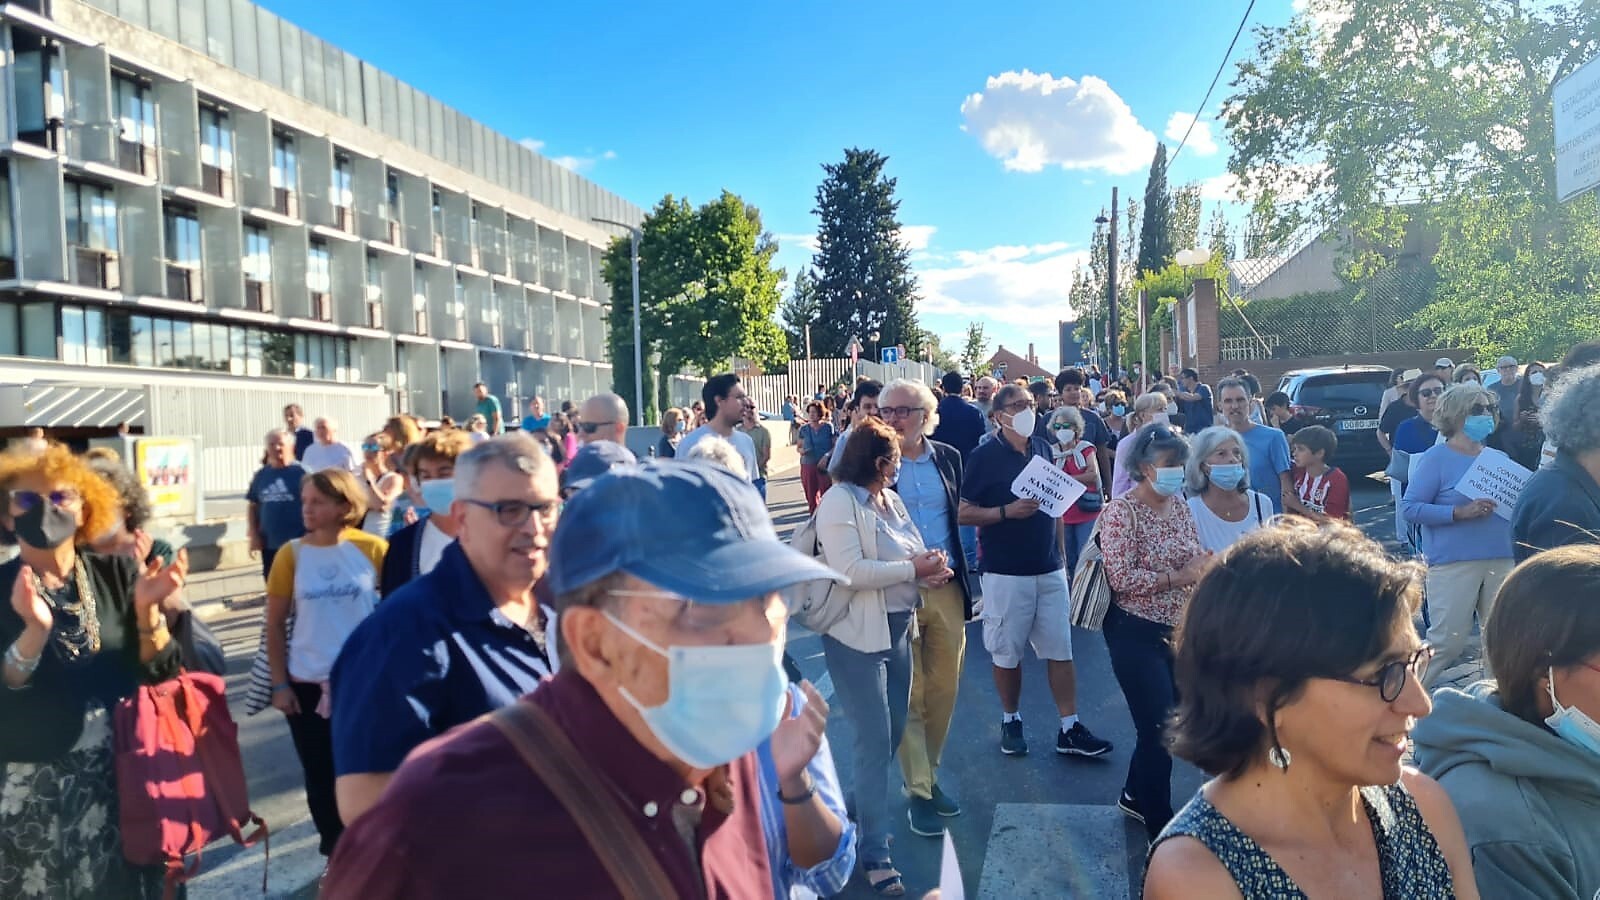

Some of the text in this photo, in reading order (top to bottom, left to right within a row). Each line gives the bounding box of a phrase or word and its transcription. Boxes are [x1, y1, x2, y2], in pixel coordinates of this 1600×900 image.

[1477, 465, 1521, 492] DESMANTELAM
[1497, 466, 1521, 484] CONTRA
[1028, 477, 1065, 501] SANIDAD
